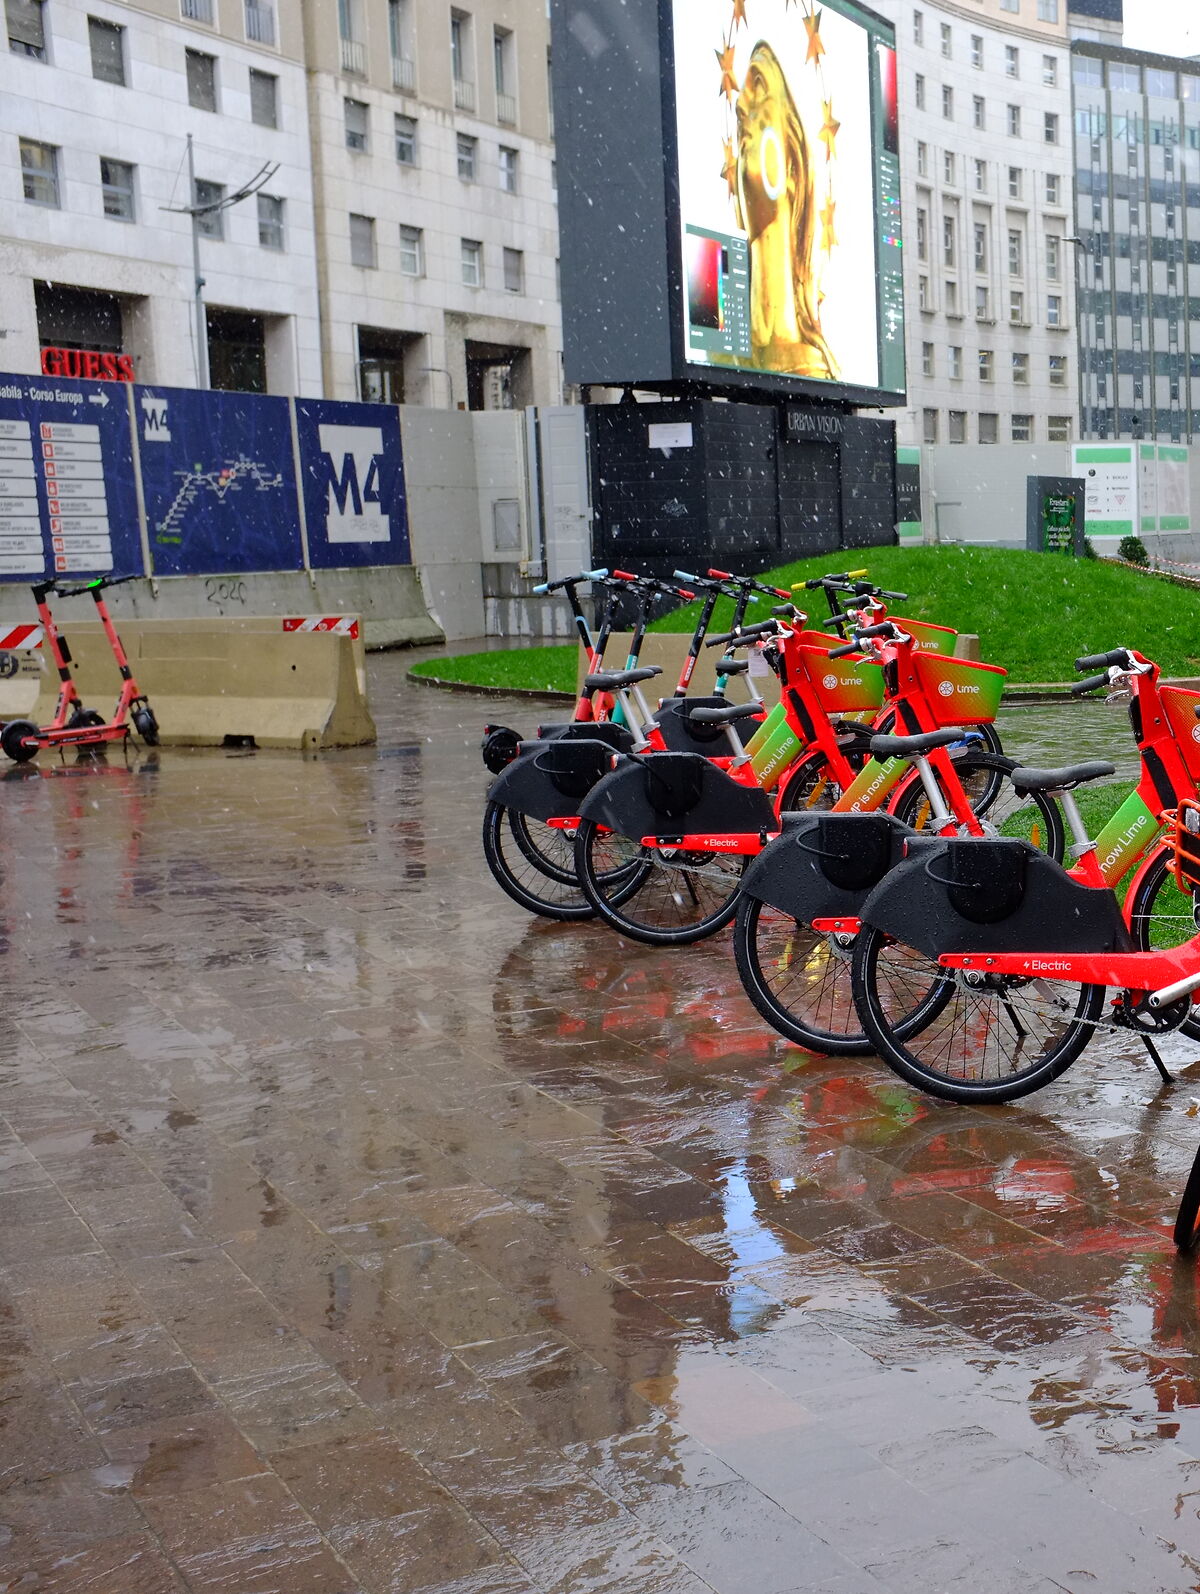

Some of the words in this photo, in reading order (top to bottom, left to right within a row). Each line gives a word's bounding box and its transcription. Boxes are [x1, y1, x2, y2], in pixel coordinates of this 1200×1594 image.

[41, 346, 135, 384] GUESS
[29, 387, 54, 401] Corso
[55, 389, 83, 405] Europa
[142, 405, 170, 434] M4
[787, 412, 815, 431] URBAN
[816, 415, 842, 434] VISION
[320, 446, 388, 520] M4
[921, 641, 939, 649] Lime
[840, 677, 863, 686] Lime
[956, 684, 980, 694] Lime
[759, 758, 777, 780] now
[772, 737, 794, 760] Lime
[859, 794, 870, 804] is
[867, 773, 885, 796] now
[709, 839, 738, 847] Electric
[1100, 844, 1123, 873] now
[1118, 815, 1147, 846] Lime
[1031, 960, 1072, 971] Electric
